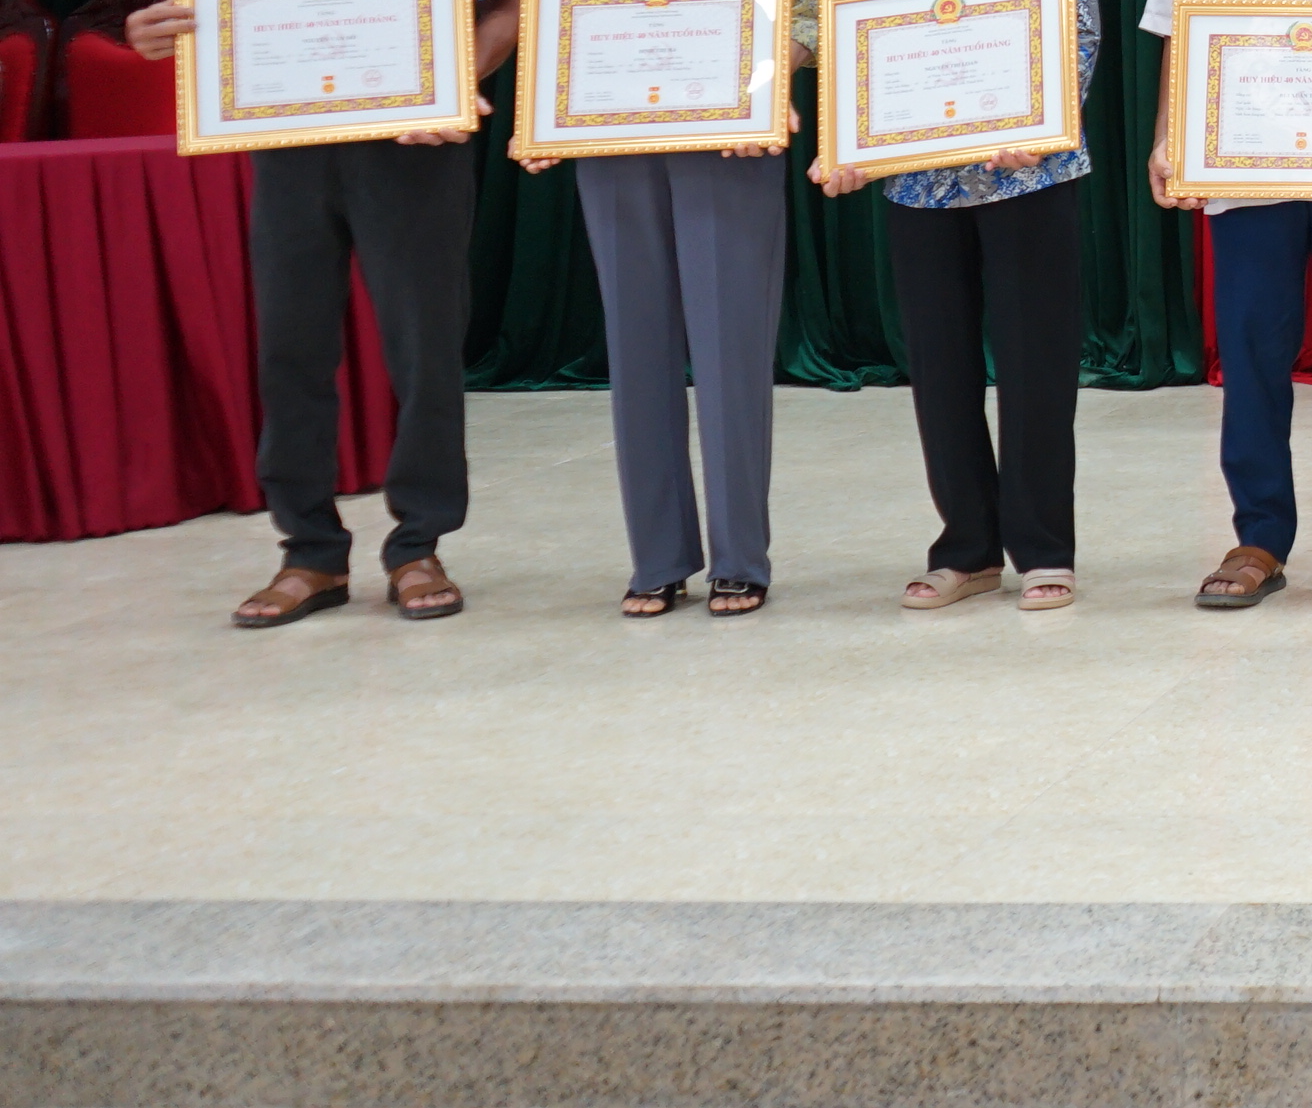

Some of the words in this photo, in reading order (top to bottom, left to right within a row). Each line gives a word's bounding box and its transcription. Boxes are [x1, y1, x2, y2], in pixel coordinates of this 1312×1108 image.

[907, 51, 928, 59] HIỆU
[964, 42, 986, 52] TUỔI
[987, 40, 1011, 48] ĐẢNG
